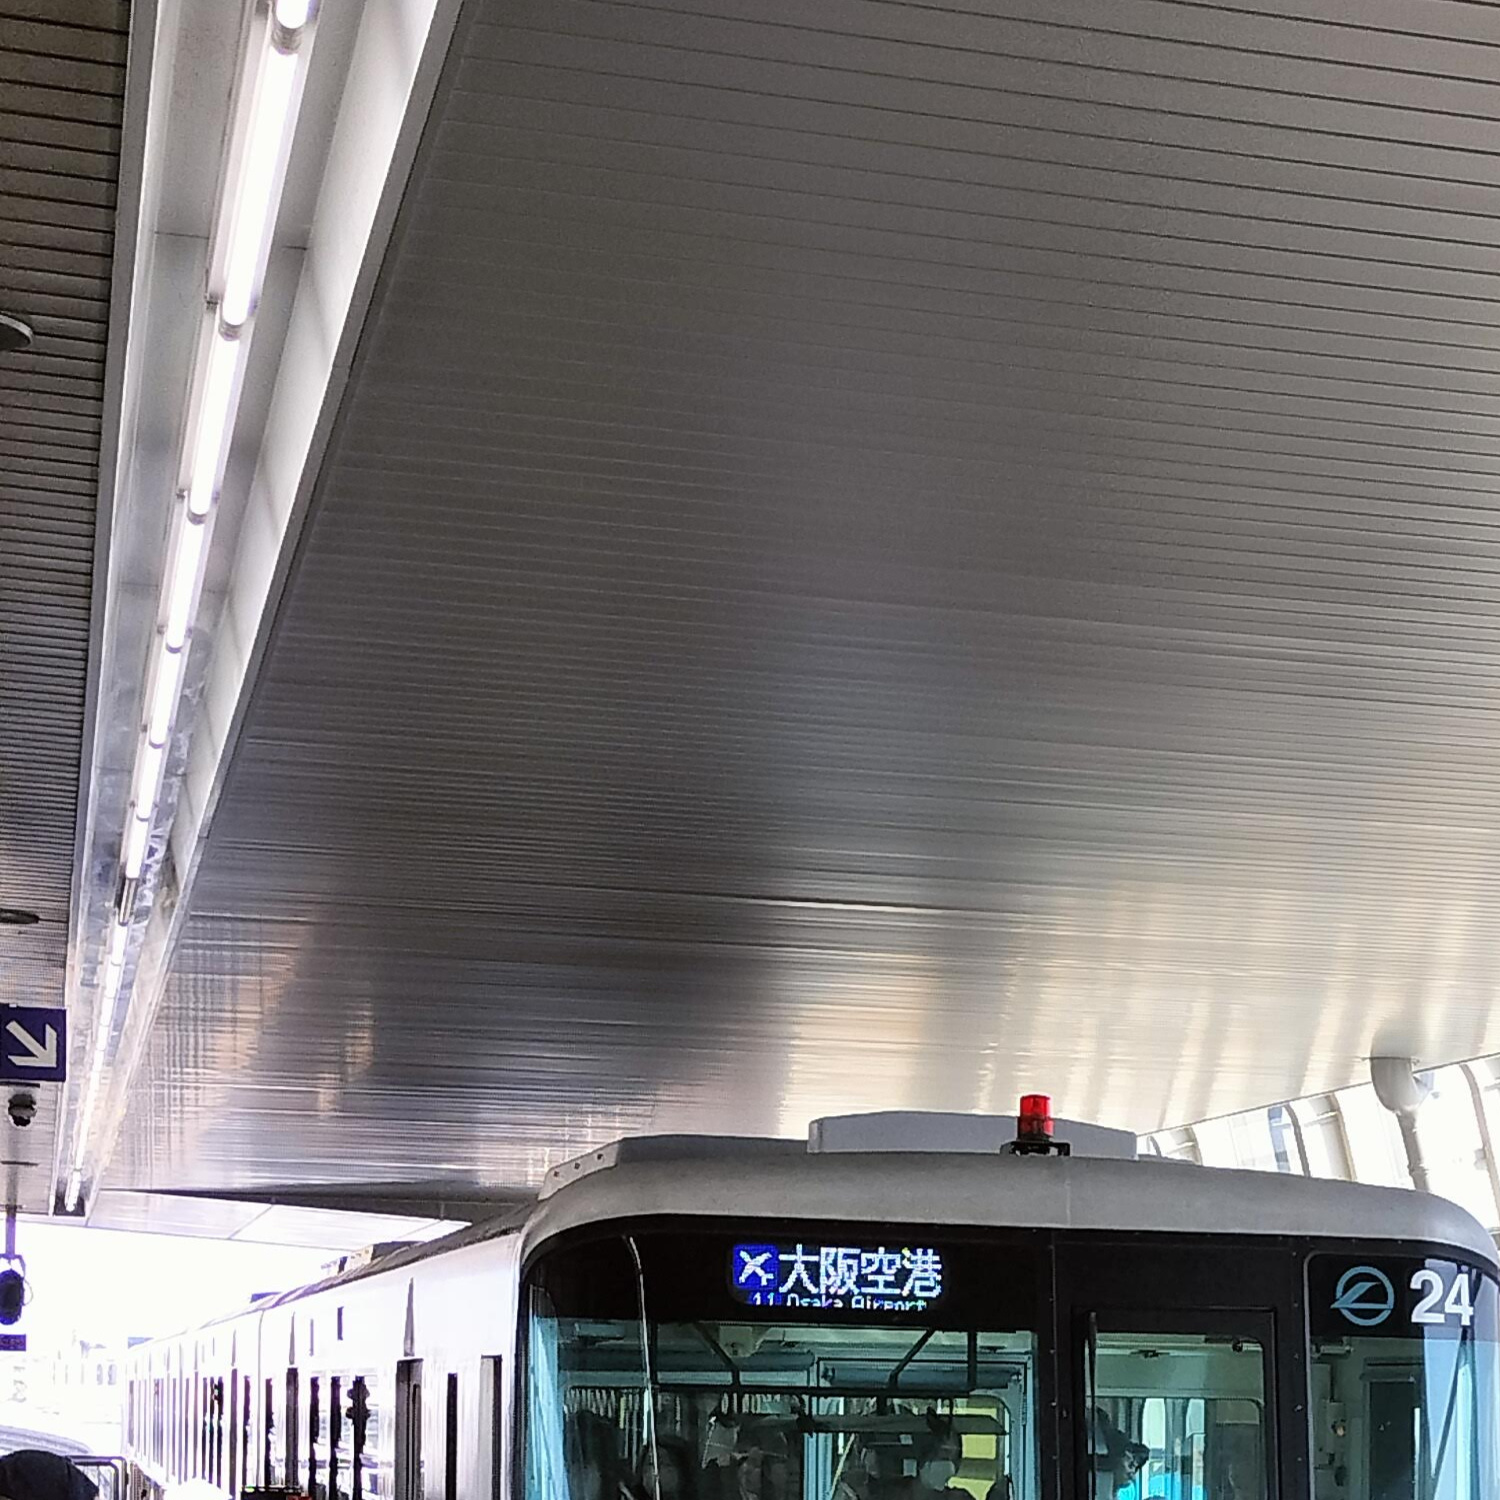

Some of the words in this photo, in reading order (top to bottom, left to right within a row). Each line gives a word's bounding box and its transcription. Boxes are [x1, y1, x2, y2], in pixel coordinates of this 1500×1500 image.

[778, 1244, 942, 1297] 大阪空港
[786, 1293, 843, 1308] Osaka
[851, 1295, 927, 1311] Airport
[1410, 1269, 1474, 1326] 24
